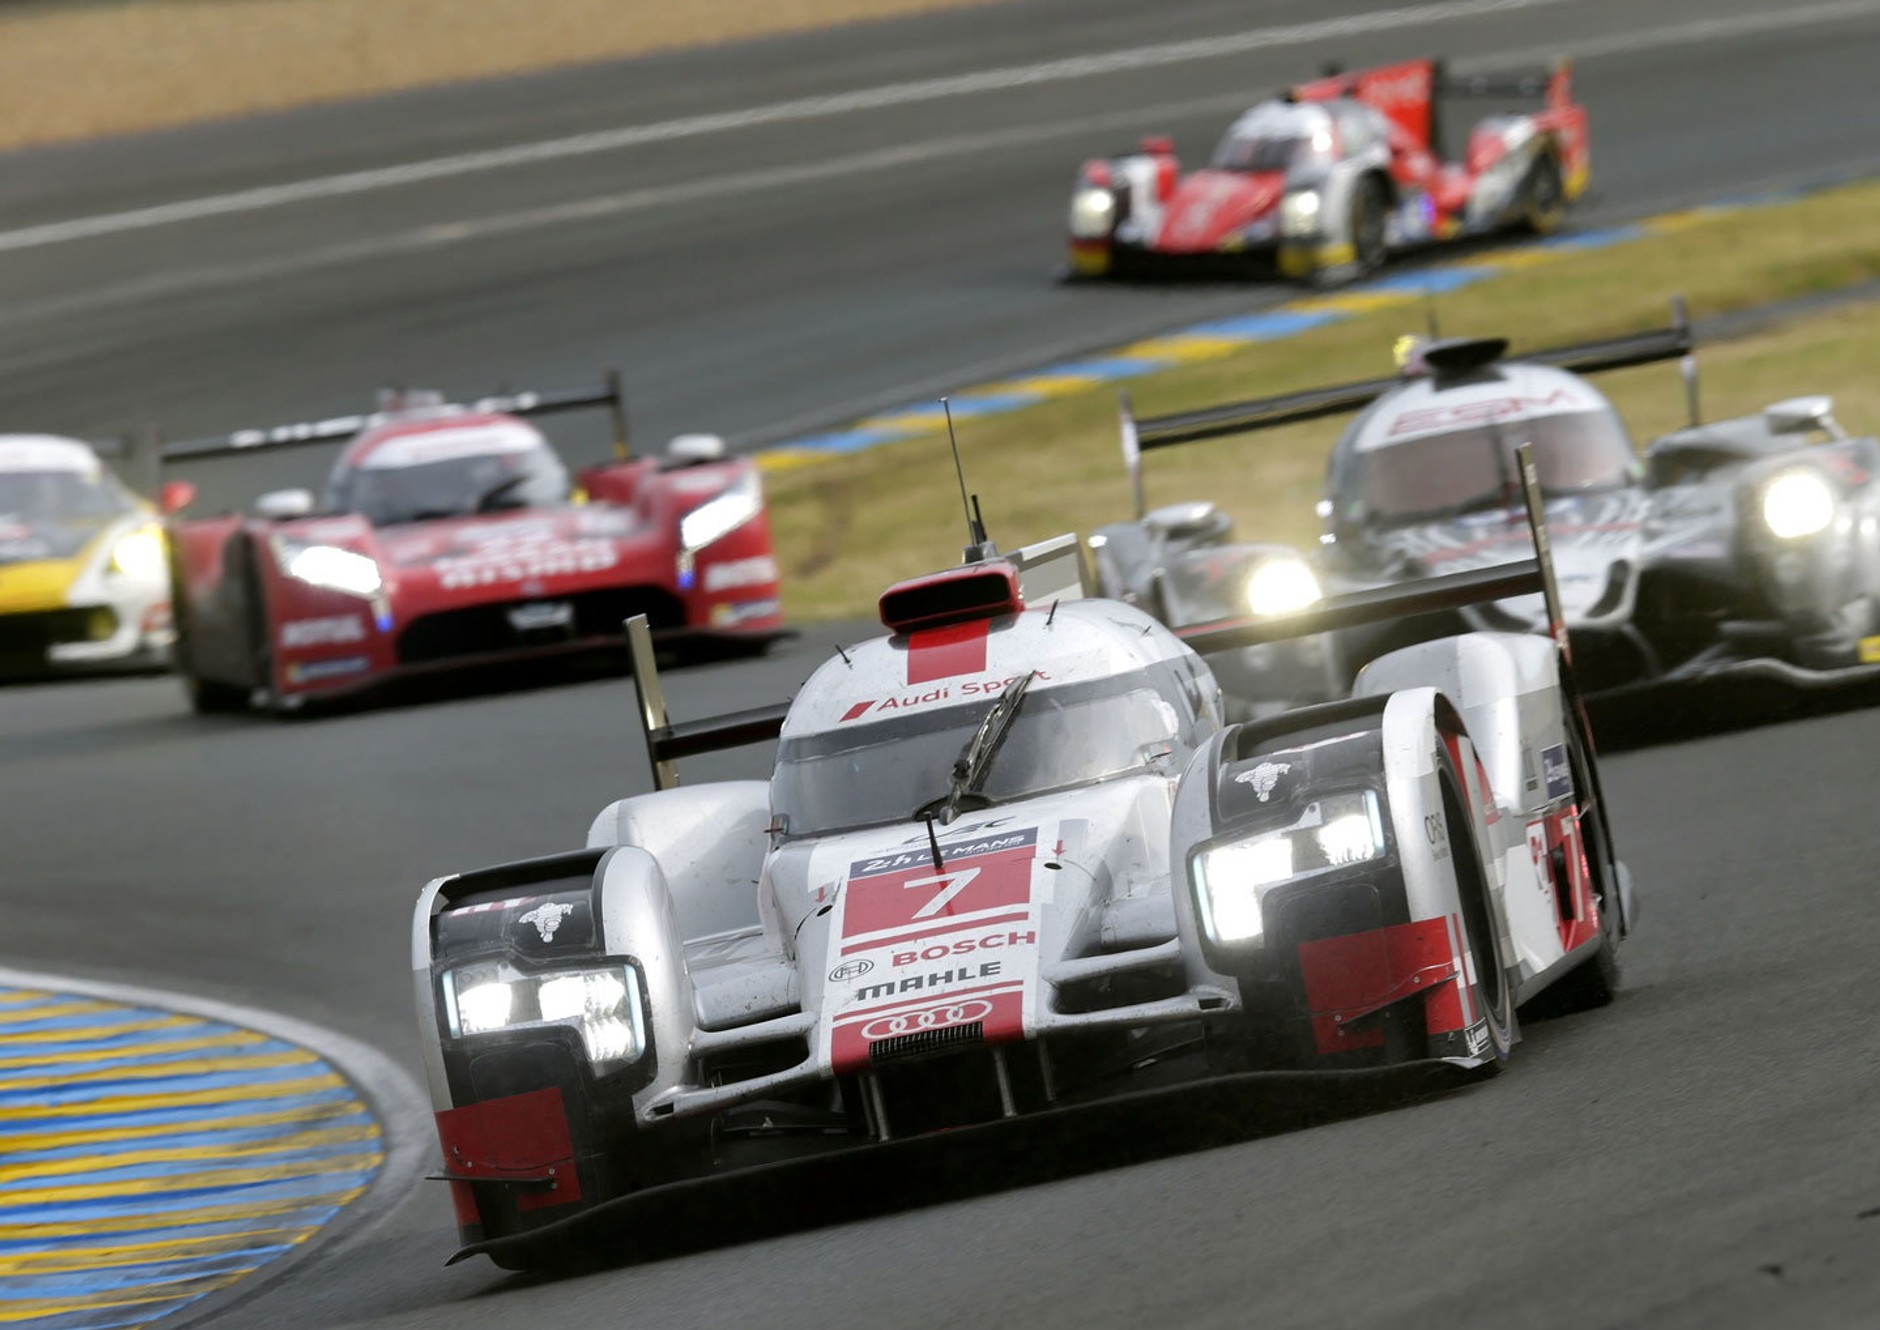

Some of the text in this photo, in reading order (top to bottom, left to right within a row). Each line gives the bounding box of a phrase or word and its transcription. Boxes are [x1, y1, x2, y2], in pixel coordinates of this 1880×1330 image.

[877, 669, 1052, 712] Audi Spot
[952, 834, 1025, 855] MANS
[904, 866, 982, 920] 7
[892, 931, 1036, 967] BOSCH
[857, 961, 1001, 1001] MAHLE
